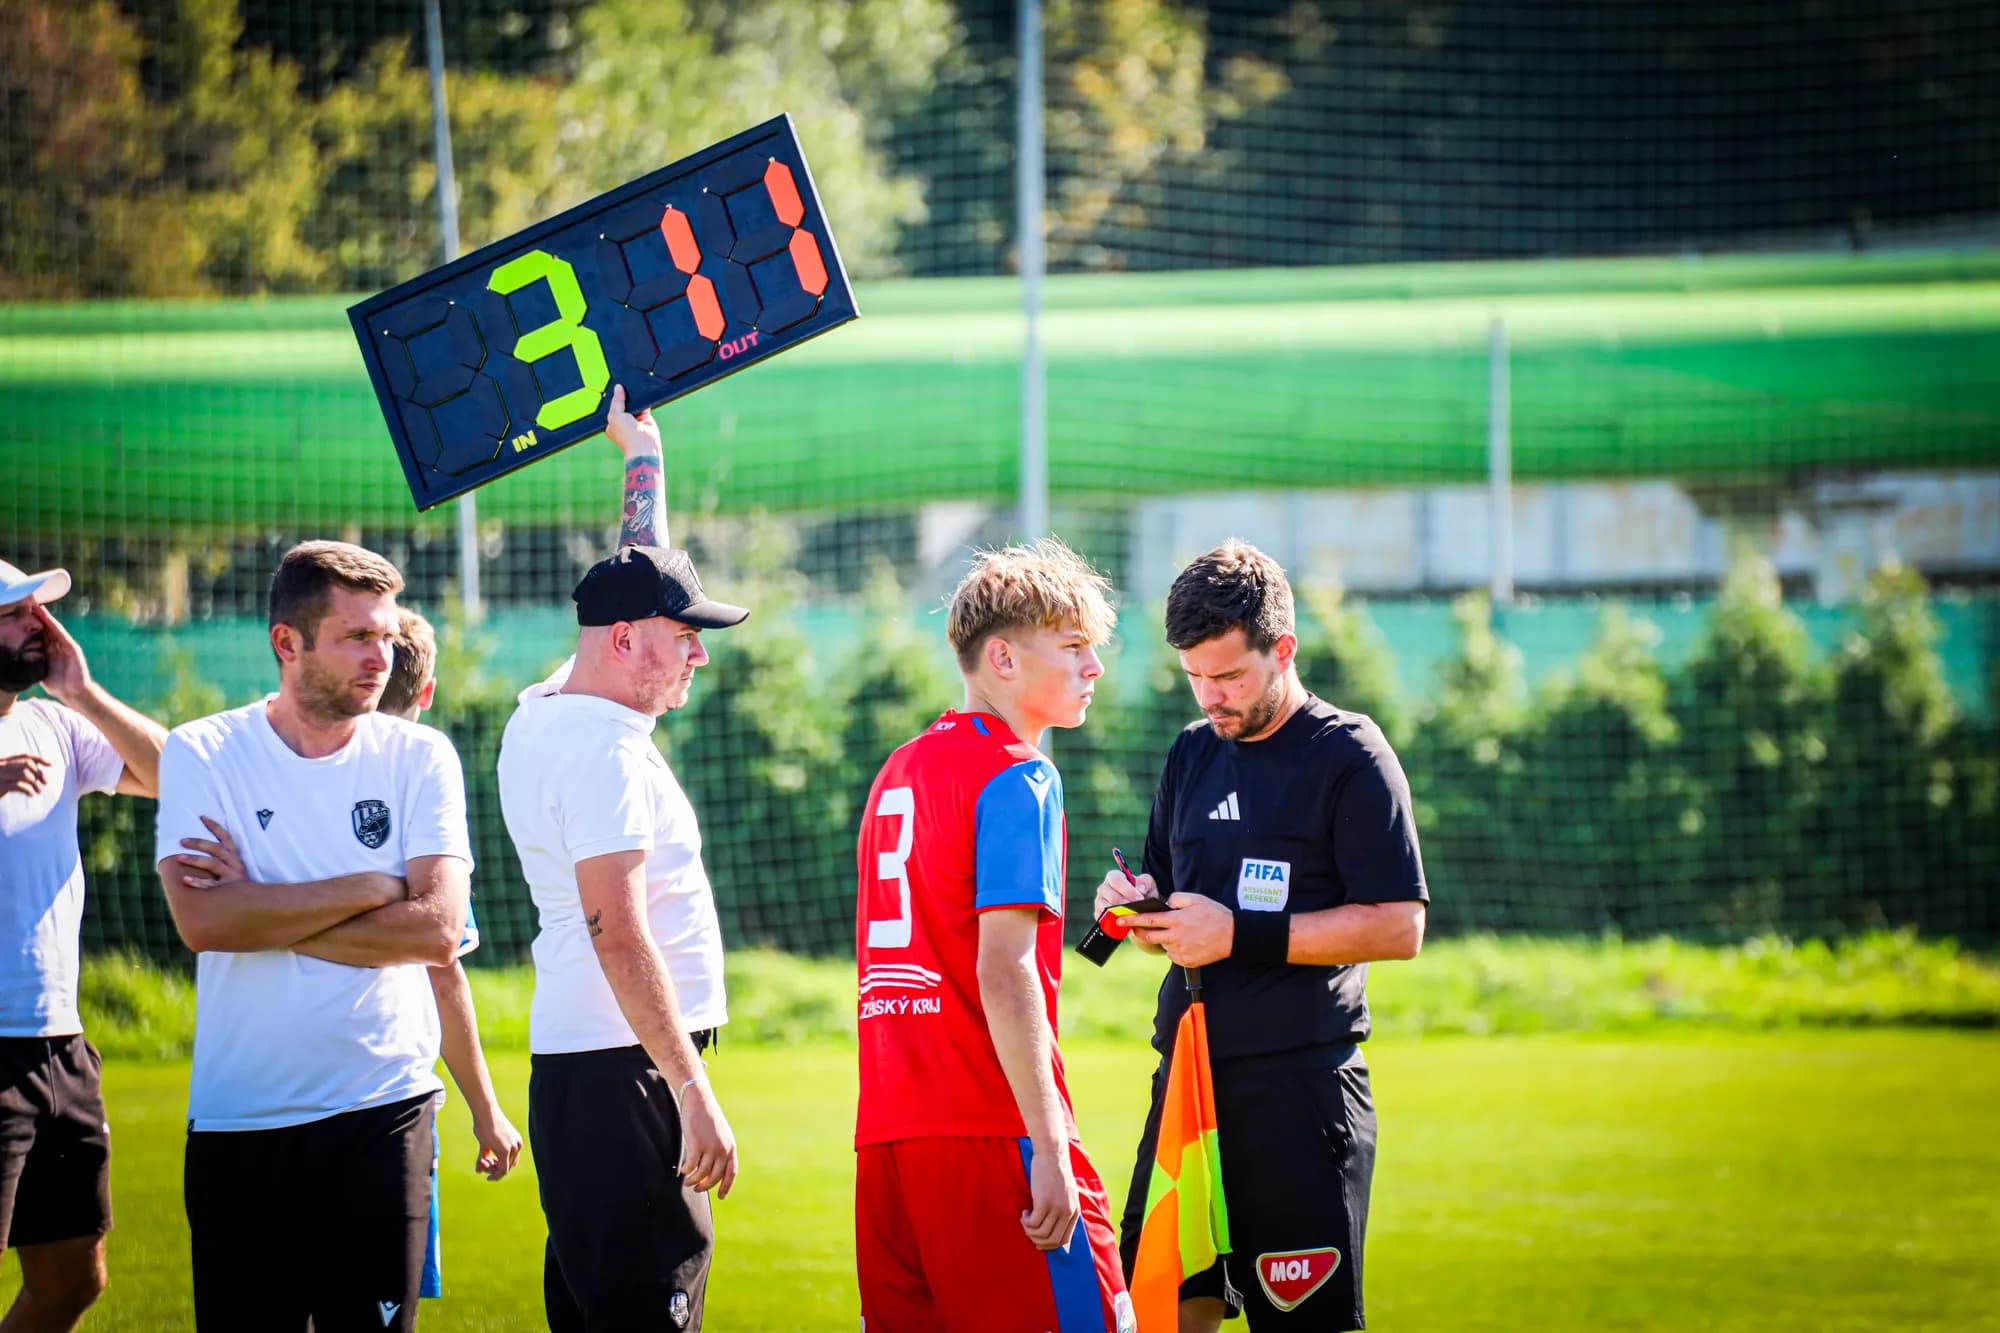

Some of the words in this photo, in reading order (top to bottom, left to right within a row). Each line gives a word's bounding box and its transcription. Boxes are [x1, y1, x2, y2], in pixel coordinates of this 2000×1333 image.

[488, 249, 611, 431] 3
[719, 331, 759, 360] OUT
[512, 430, 538, 453] IN
[867, 786, 915, 949] 3
[1244, 863, 1285, 882] FIFA
[1270, 1259, 1312, 1282] MOL
